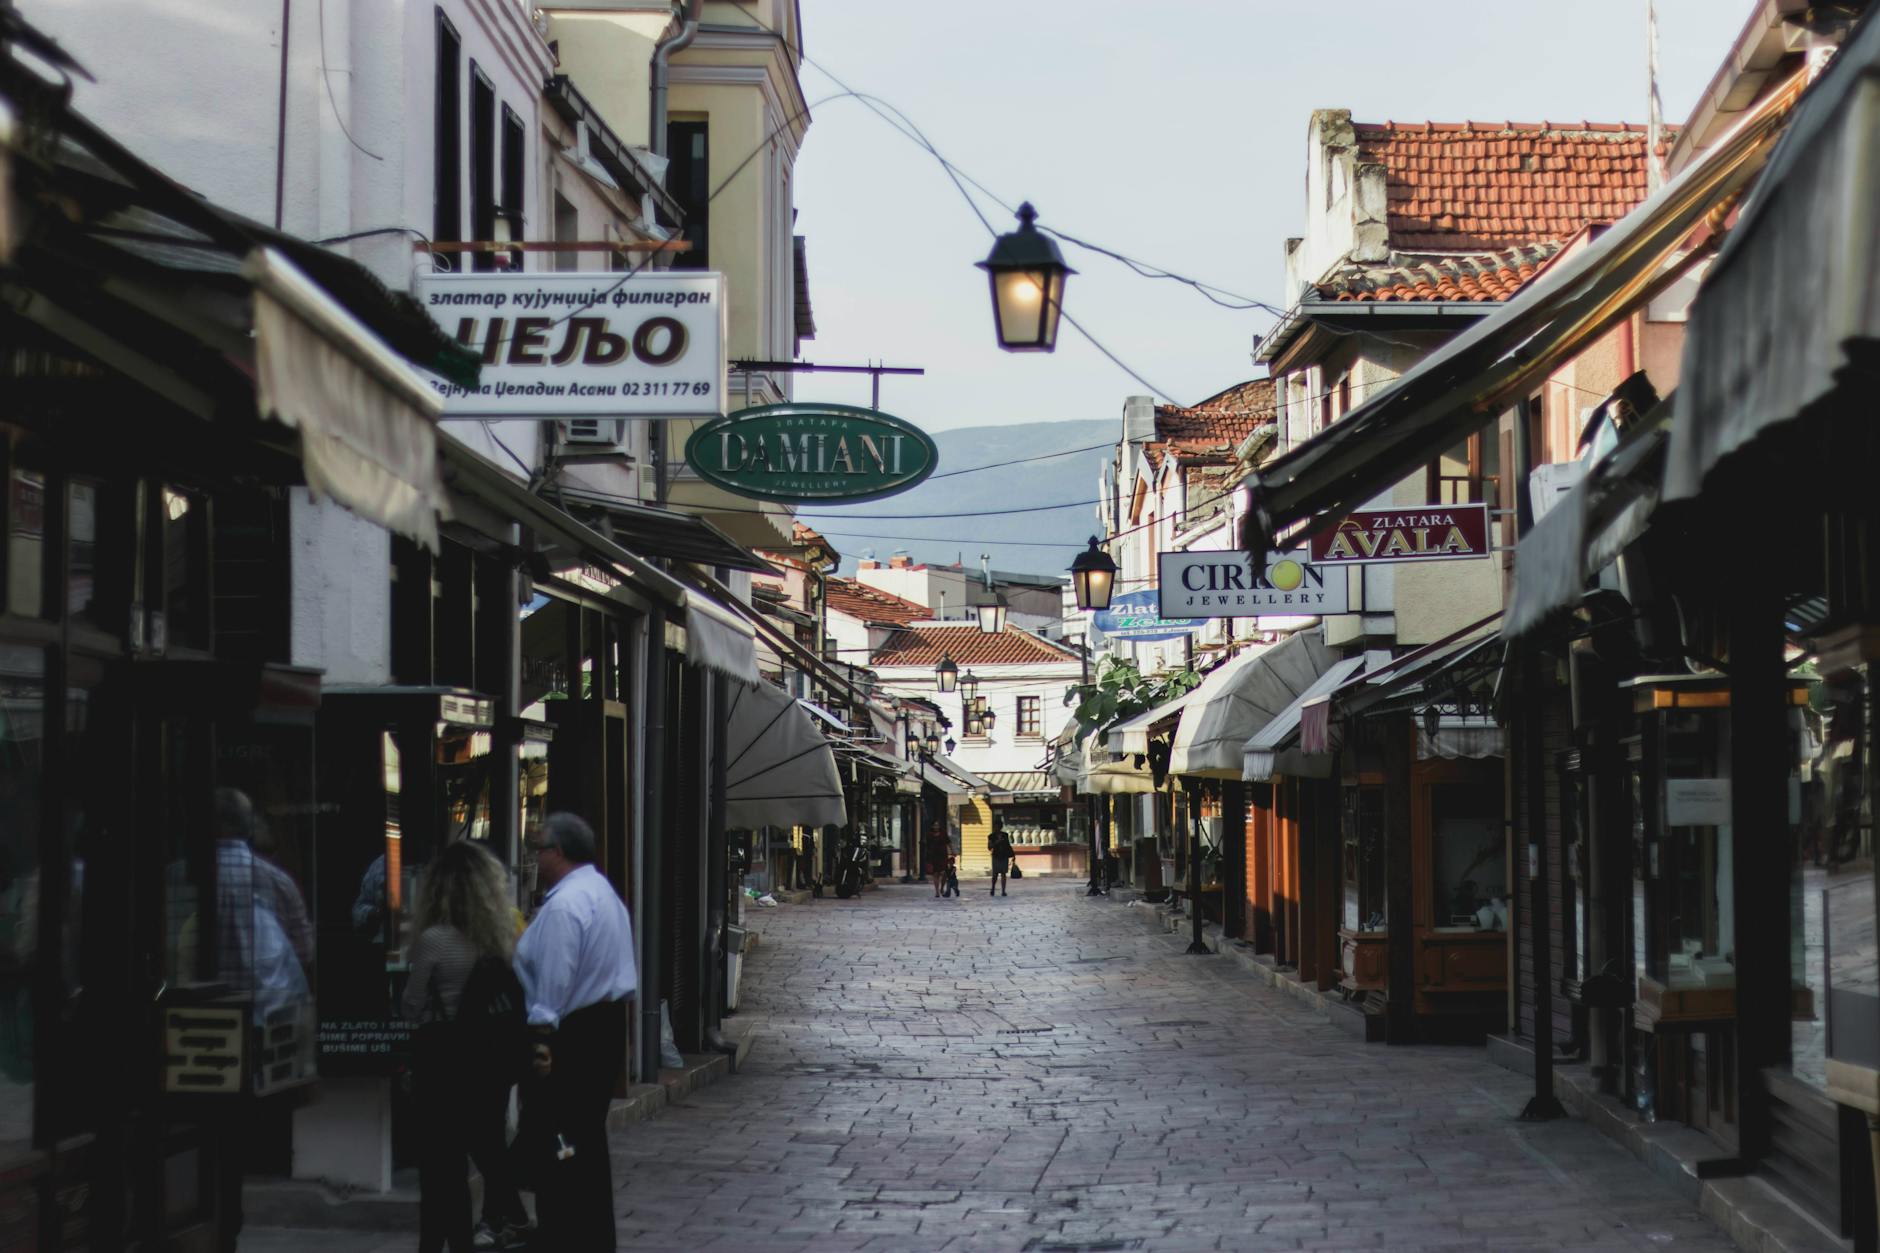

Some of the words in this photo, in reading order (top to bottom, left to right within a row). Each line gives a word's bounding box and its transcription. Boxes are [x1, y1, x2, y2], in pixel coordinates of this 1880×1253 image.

[429, 290, 507, 308] златар
[512, 287, 607, 309] кујунџија
[612, 287, 711, 307] филигран
[569, 381, 616, 396] Асани
[622, 382, 641, 396] 02
[643, 382, 668, 396] 311
[672, 382, 691, 396] 77
[692, 382, 711, 396] 69
[717, 432, 905, 475] DAMIANI
[1372, 513, 1455, 529] ZLATARA
[1323, 524, 1473, 559] AVALA
[1186, 593, 1326, 606] JEWELLERY
[341, 1021, 378, 1030] ZLATO
